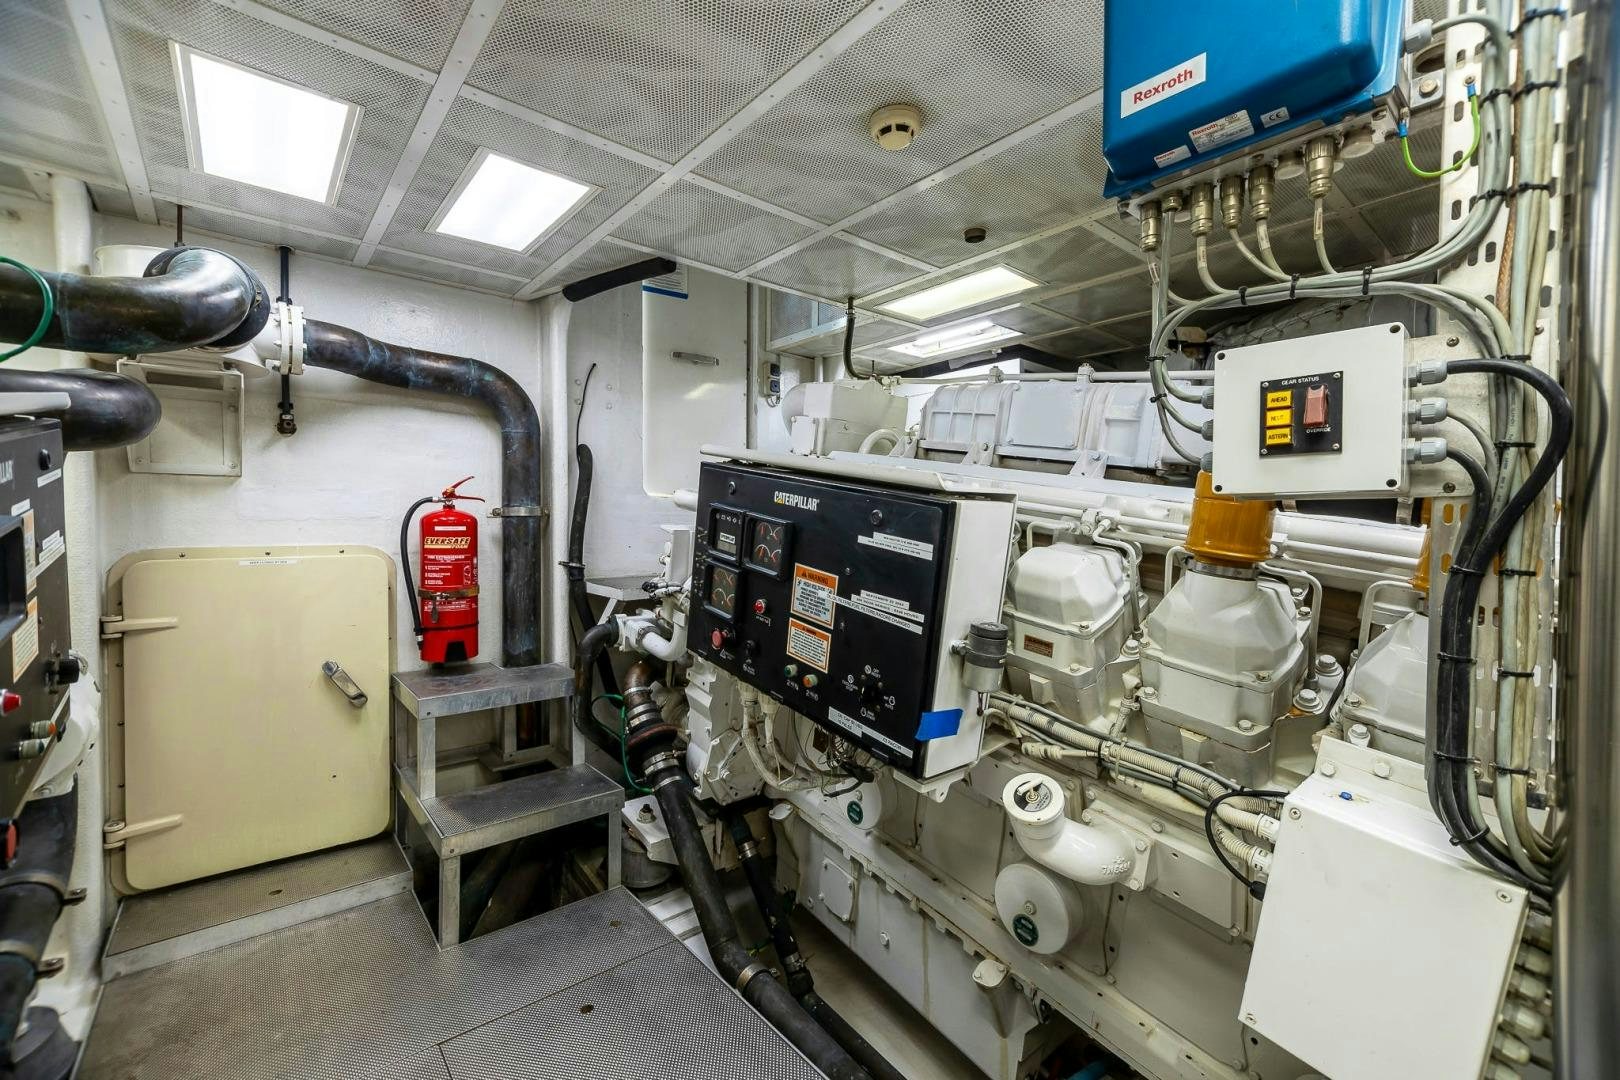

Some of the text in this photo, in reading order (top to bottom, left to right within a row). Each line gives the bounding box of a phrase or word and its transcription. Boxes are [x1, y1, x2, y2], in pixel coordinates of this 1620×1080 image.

[1133, 68, 1193, 104] Rexroth
[1191, 123, 1219, 137] Rexroth
[1268, 433, 1288, 441] ASTERN
[774, 490, 818, 511] CATERPILLAR
[425, 537, 471, 545] EVERSAFE
[806, 572, 829, 585] WARNING
